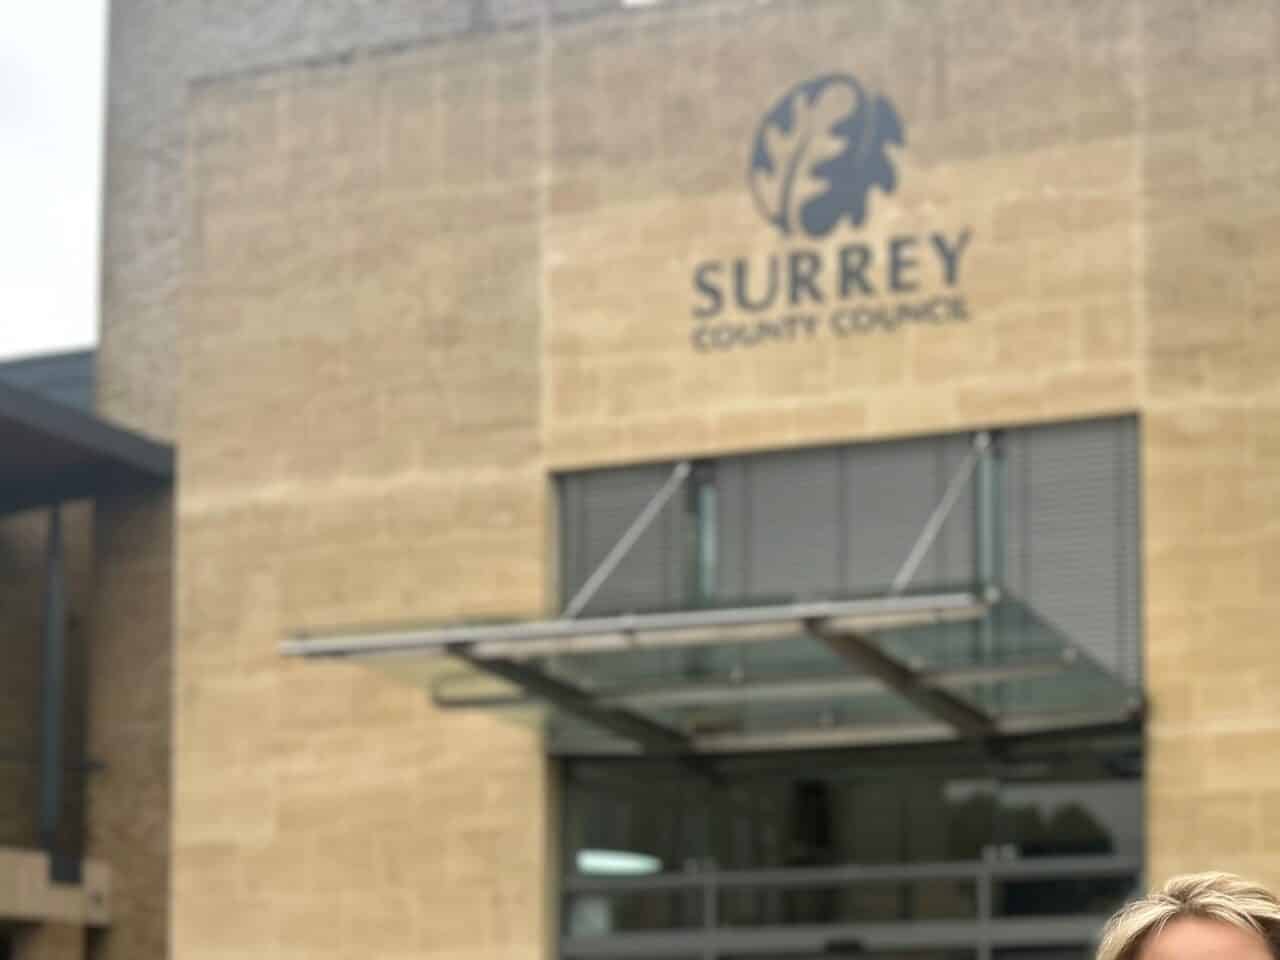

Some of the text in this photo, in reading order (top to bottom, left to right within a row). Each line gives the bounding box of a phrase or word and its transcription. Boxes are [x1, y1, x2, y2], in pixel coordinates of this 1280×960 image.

[692, 229, 972, 317] SURREY
[691, 298, 970, 351] COUNTY COUNCIL
